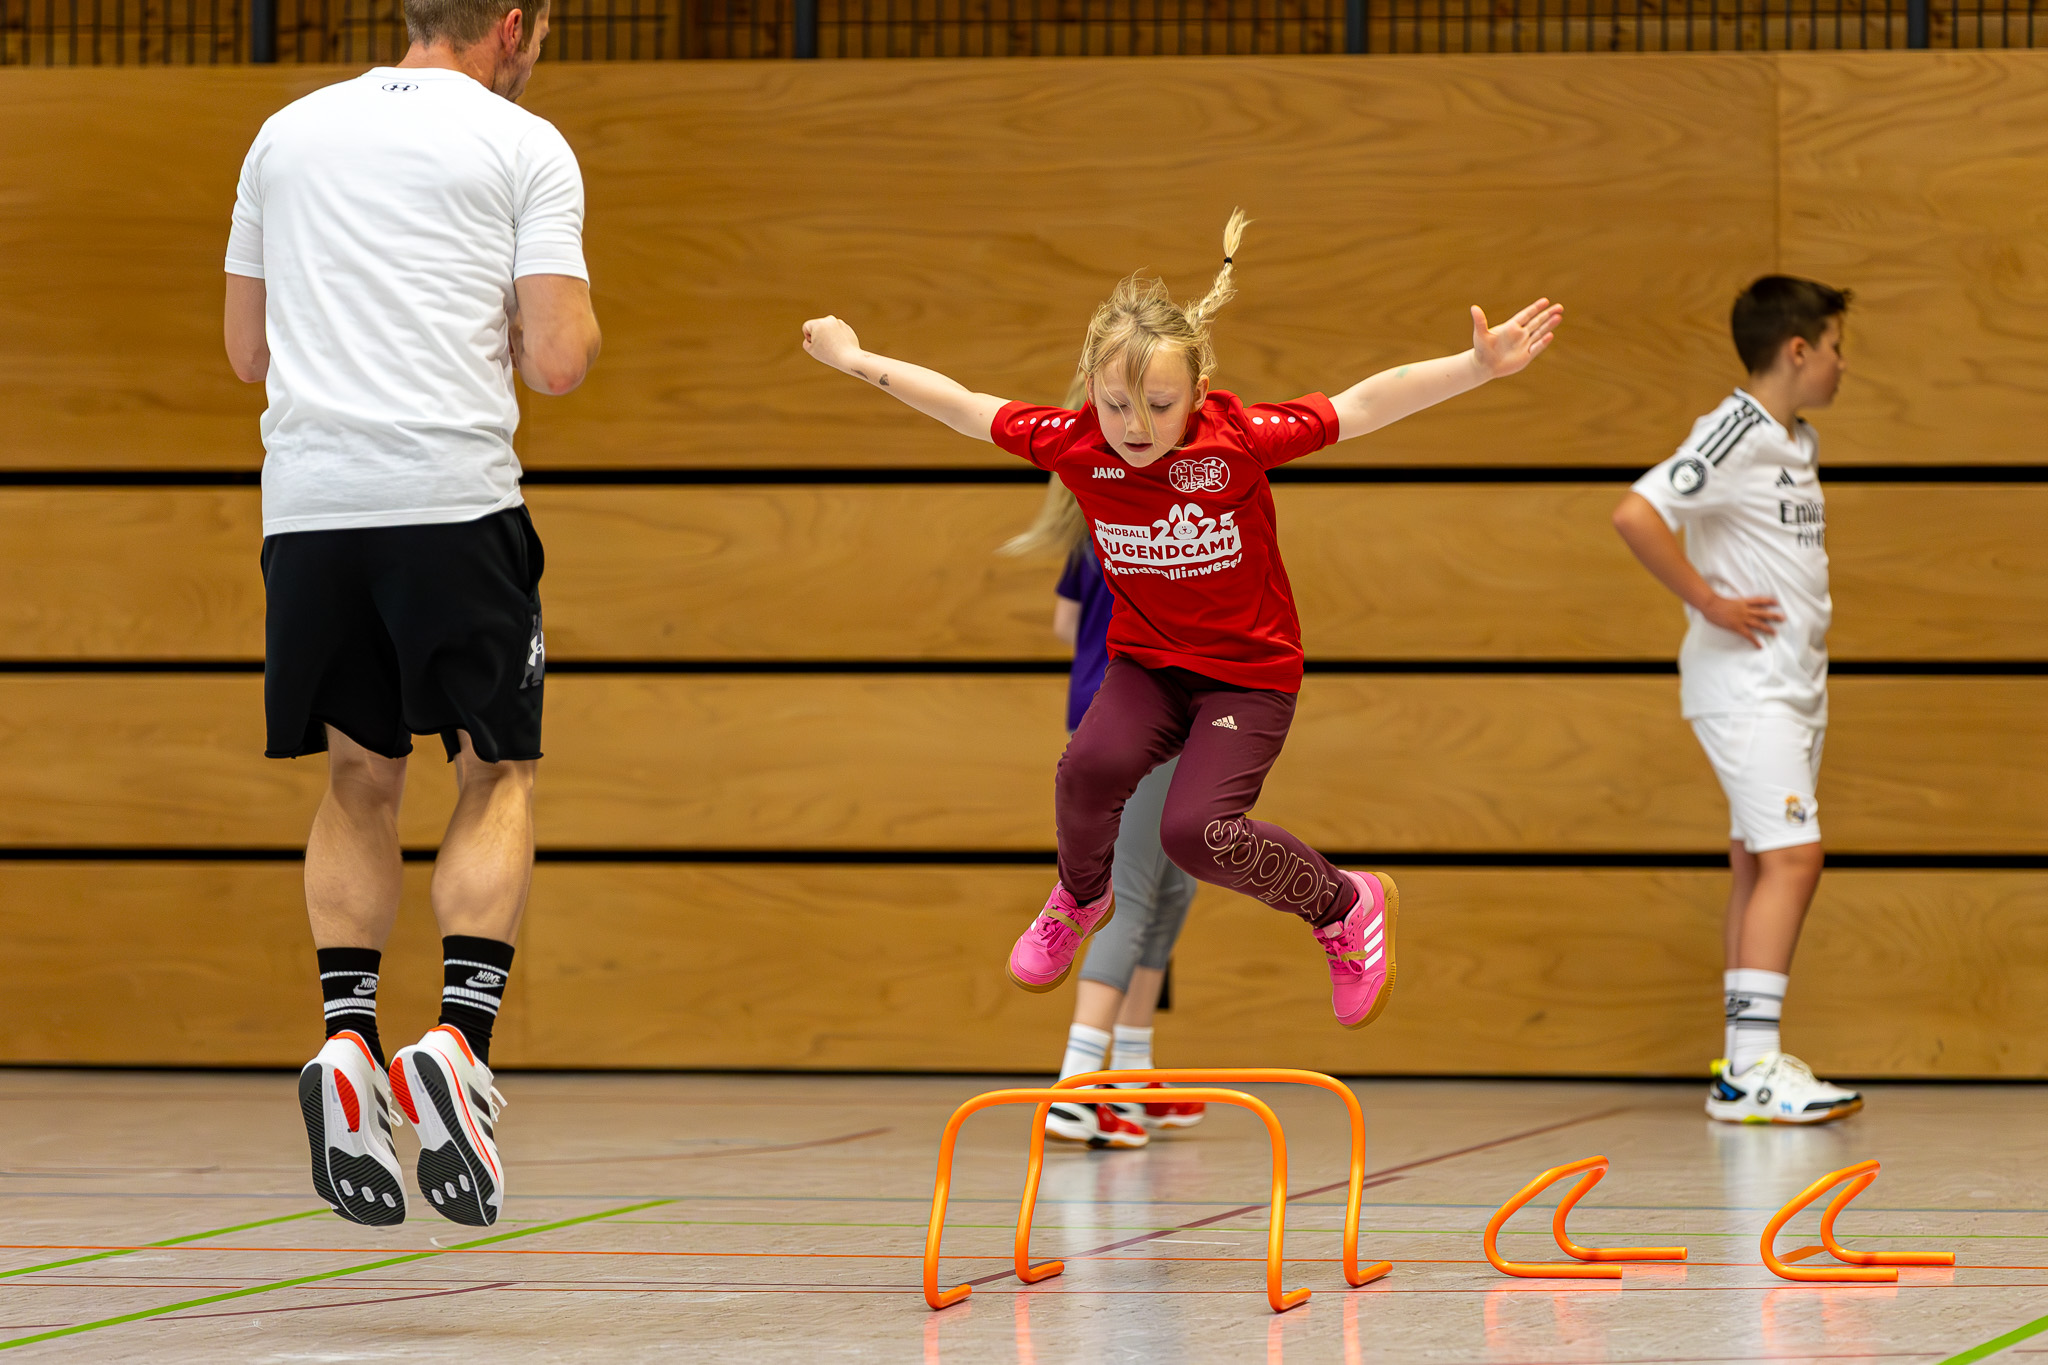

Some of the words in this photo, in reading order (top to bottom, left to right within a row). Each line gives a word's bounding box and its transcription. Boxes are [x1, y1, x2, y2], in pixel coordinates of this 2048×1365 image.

[1091, 466, 1126, 479] JAKO
[1176, 462, 1222, 482] HSG
[1096, 523, 1149, 539] HANDBALL
[1102, 535, 1236, 561] JUGENDCAMP
[474, 970, 501, 986] NIKE
